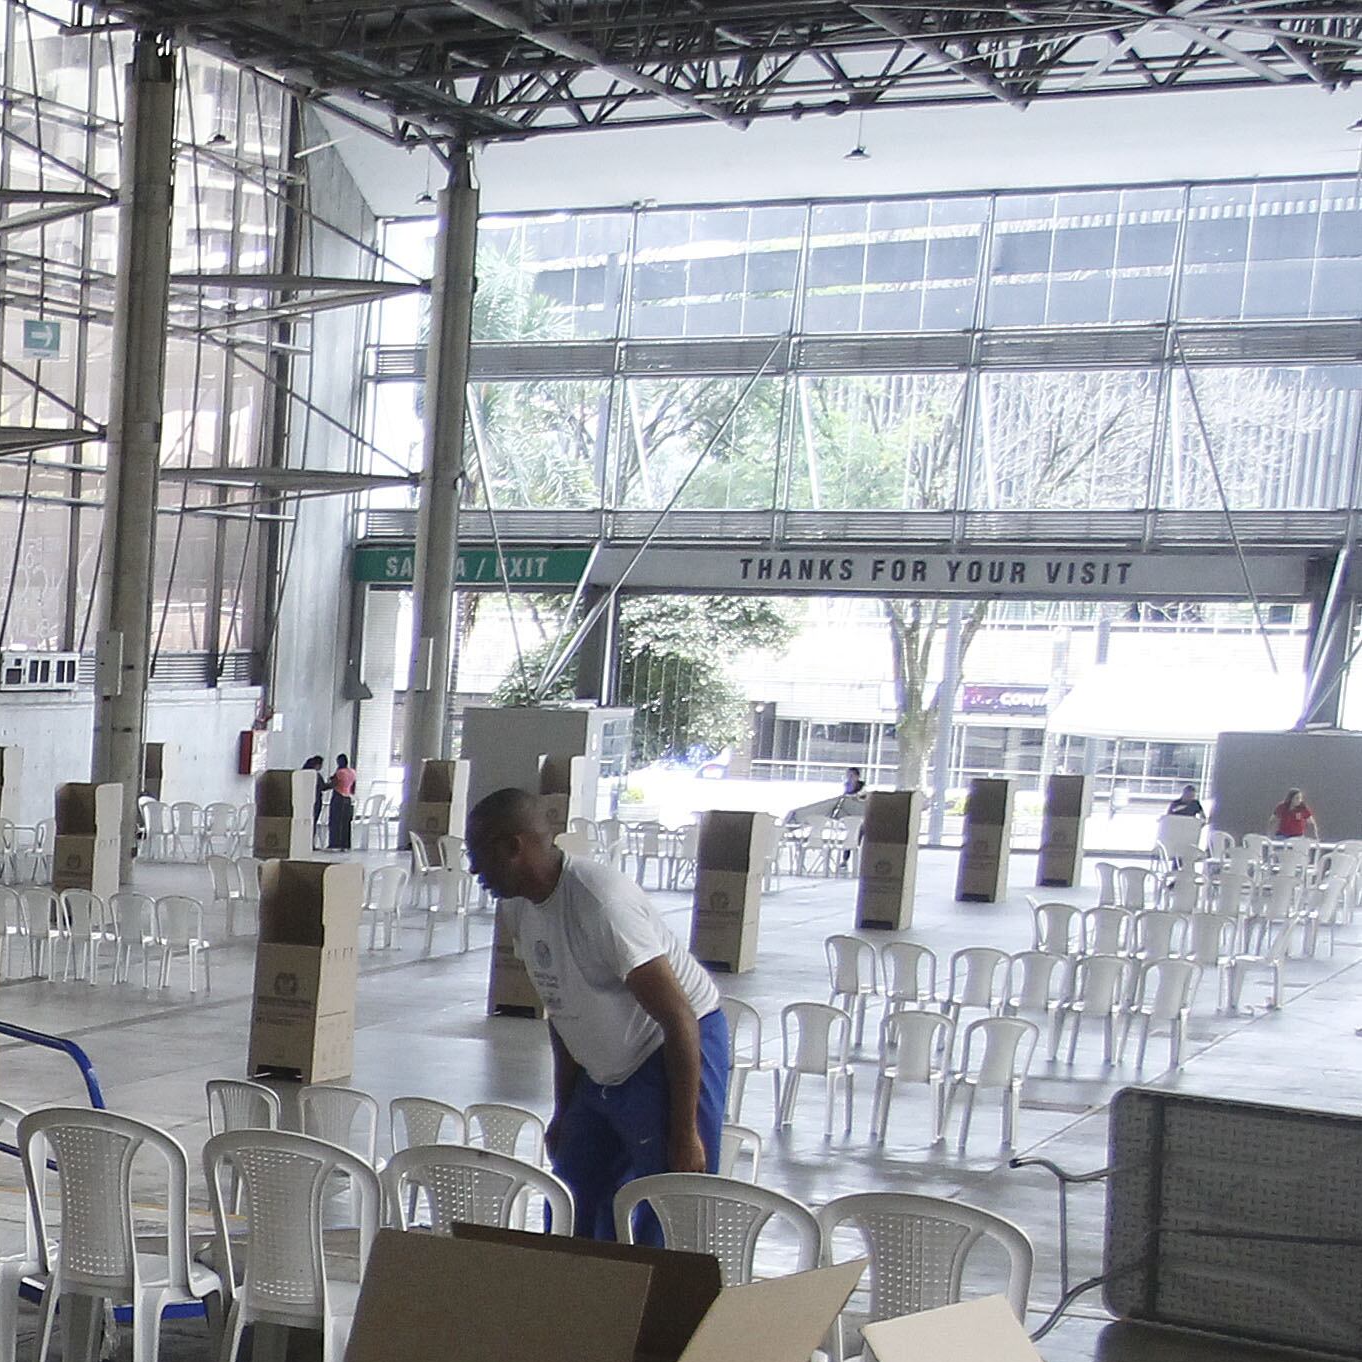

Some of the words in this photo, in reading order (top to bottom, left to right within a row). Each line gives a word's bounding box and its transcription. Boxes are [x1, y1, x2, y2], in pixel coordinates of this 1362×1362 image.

[386, 556, 466, 578] SAA
[495, 556, 549, 578] EXIT
[739, 557, 854, 581] THANKS
[870, 560, 927, 583] FOR
[945, 560, 1026, 584] YOUR
[1045, 561, 1133, 586] VISIT
